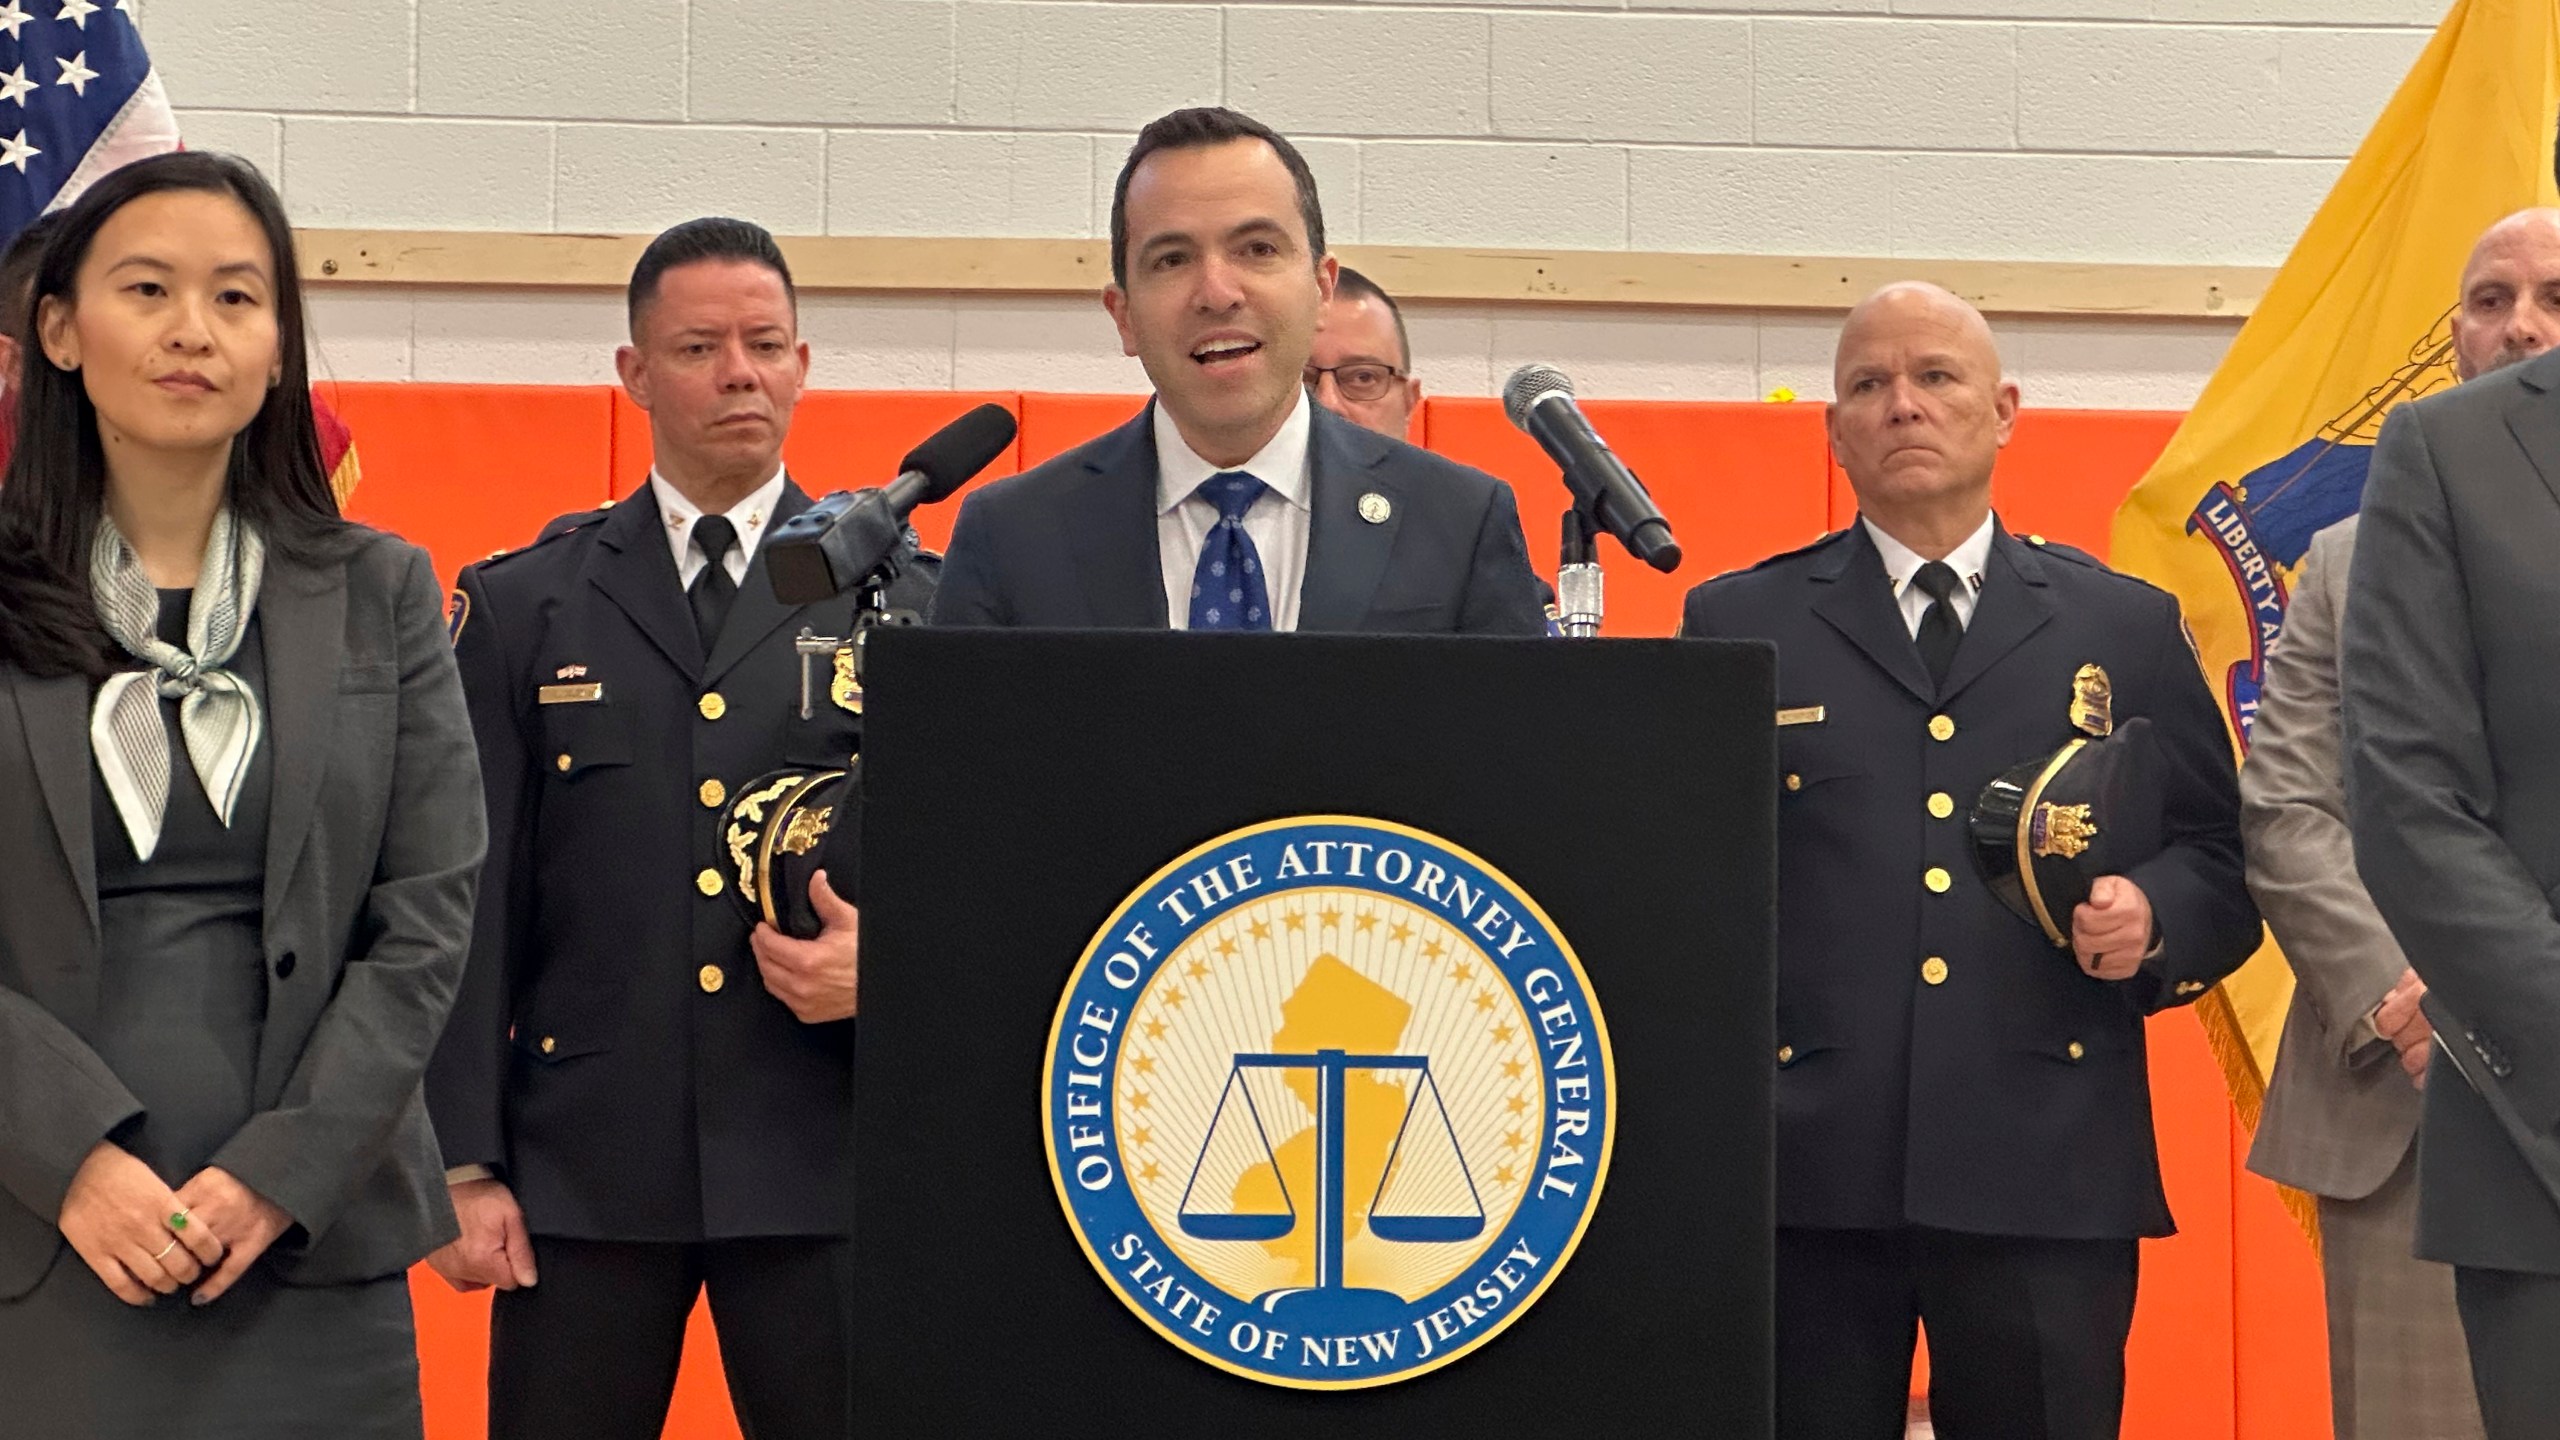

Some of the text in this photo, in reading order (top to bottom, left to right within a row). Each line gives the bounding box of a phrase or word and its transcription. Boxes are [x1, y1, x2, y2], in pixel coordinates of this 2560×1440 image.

[2206, 499, 2280, 612] LIBERTY
[1067, 841, 1591, 1201] OFFICE OF THE ATTORNEY GENERAL
[1111, 1232, 1541, 1367] STATE OF NEW JERSEY
